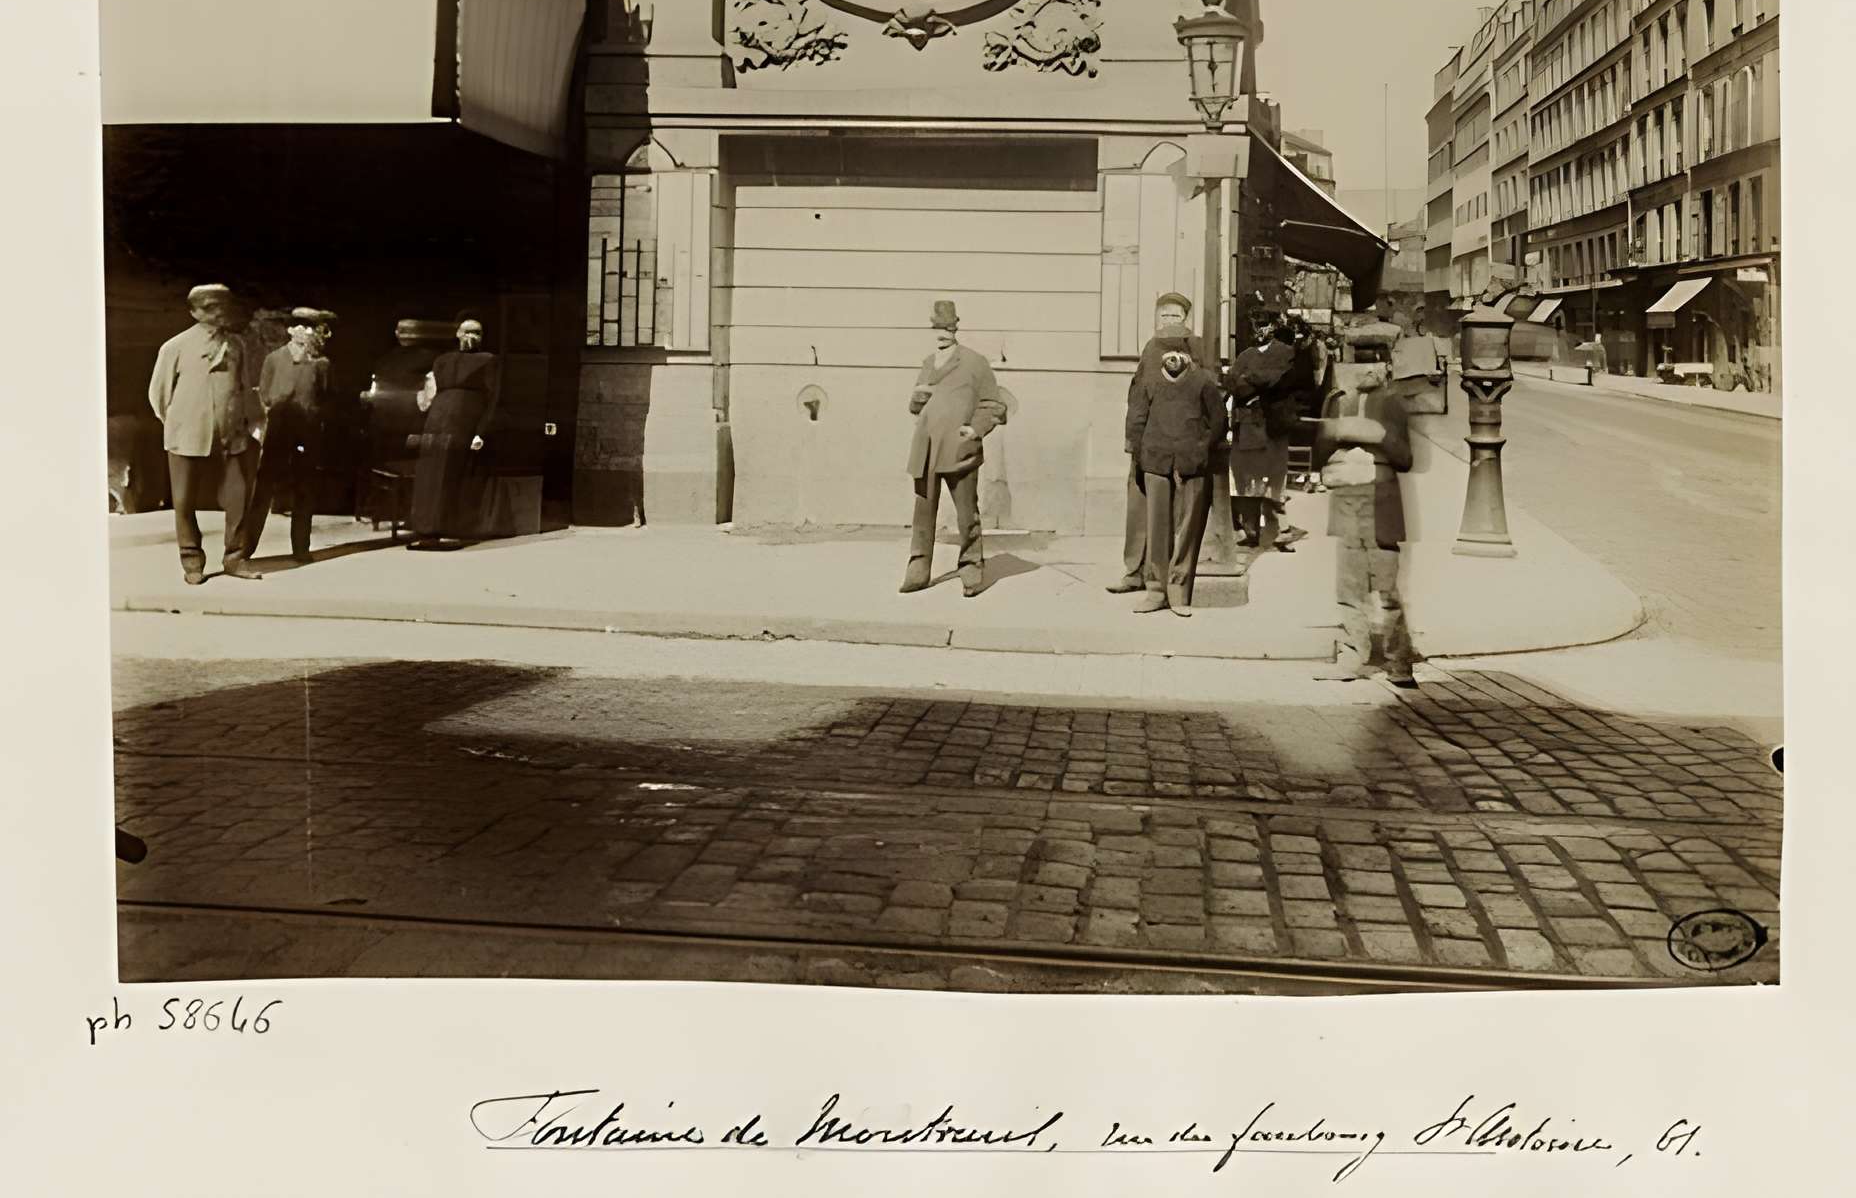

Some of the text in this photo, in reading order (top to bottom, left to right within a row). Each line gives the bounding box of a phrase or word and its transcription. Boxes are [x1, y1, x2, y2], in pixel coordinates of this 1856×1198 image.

[86, 995, 283, 1045] ph 58646
[470, 1090, 705, 1145] Fontaine
[720, 1114, 769, 1146] de
